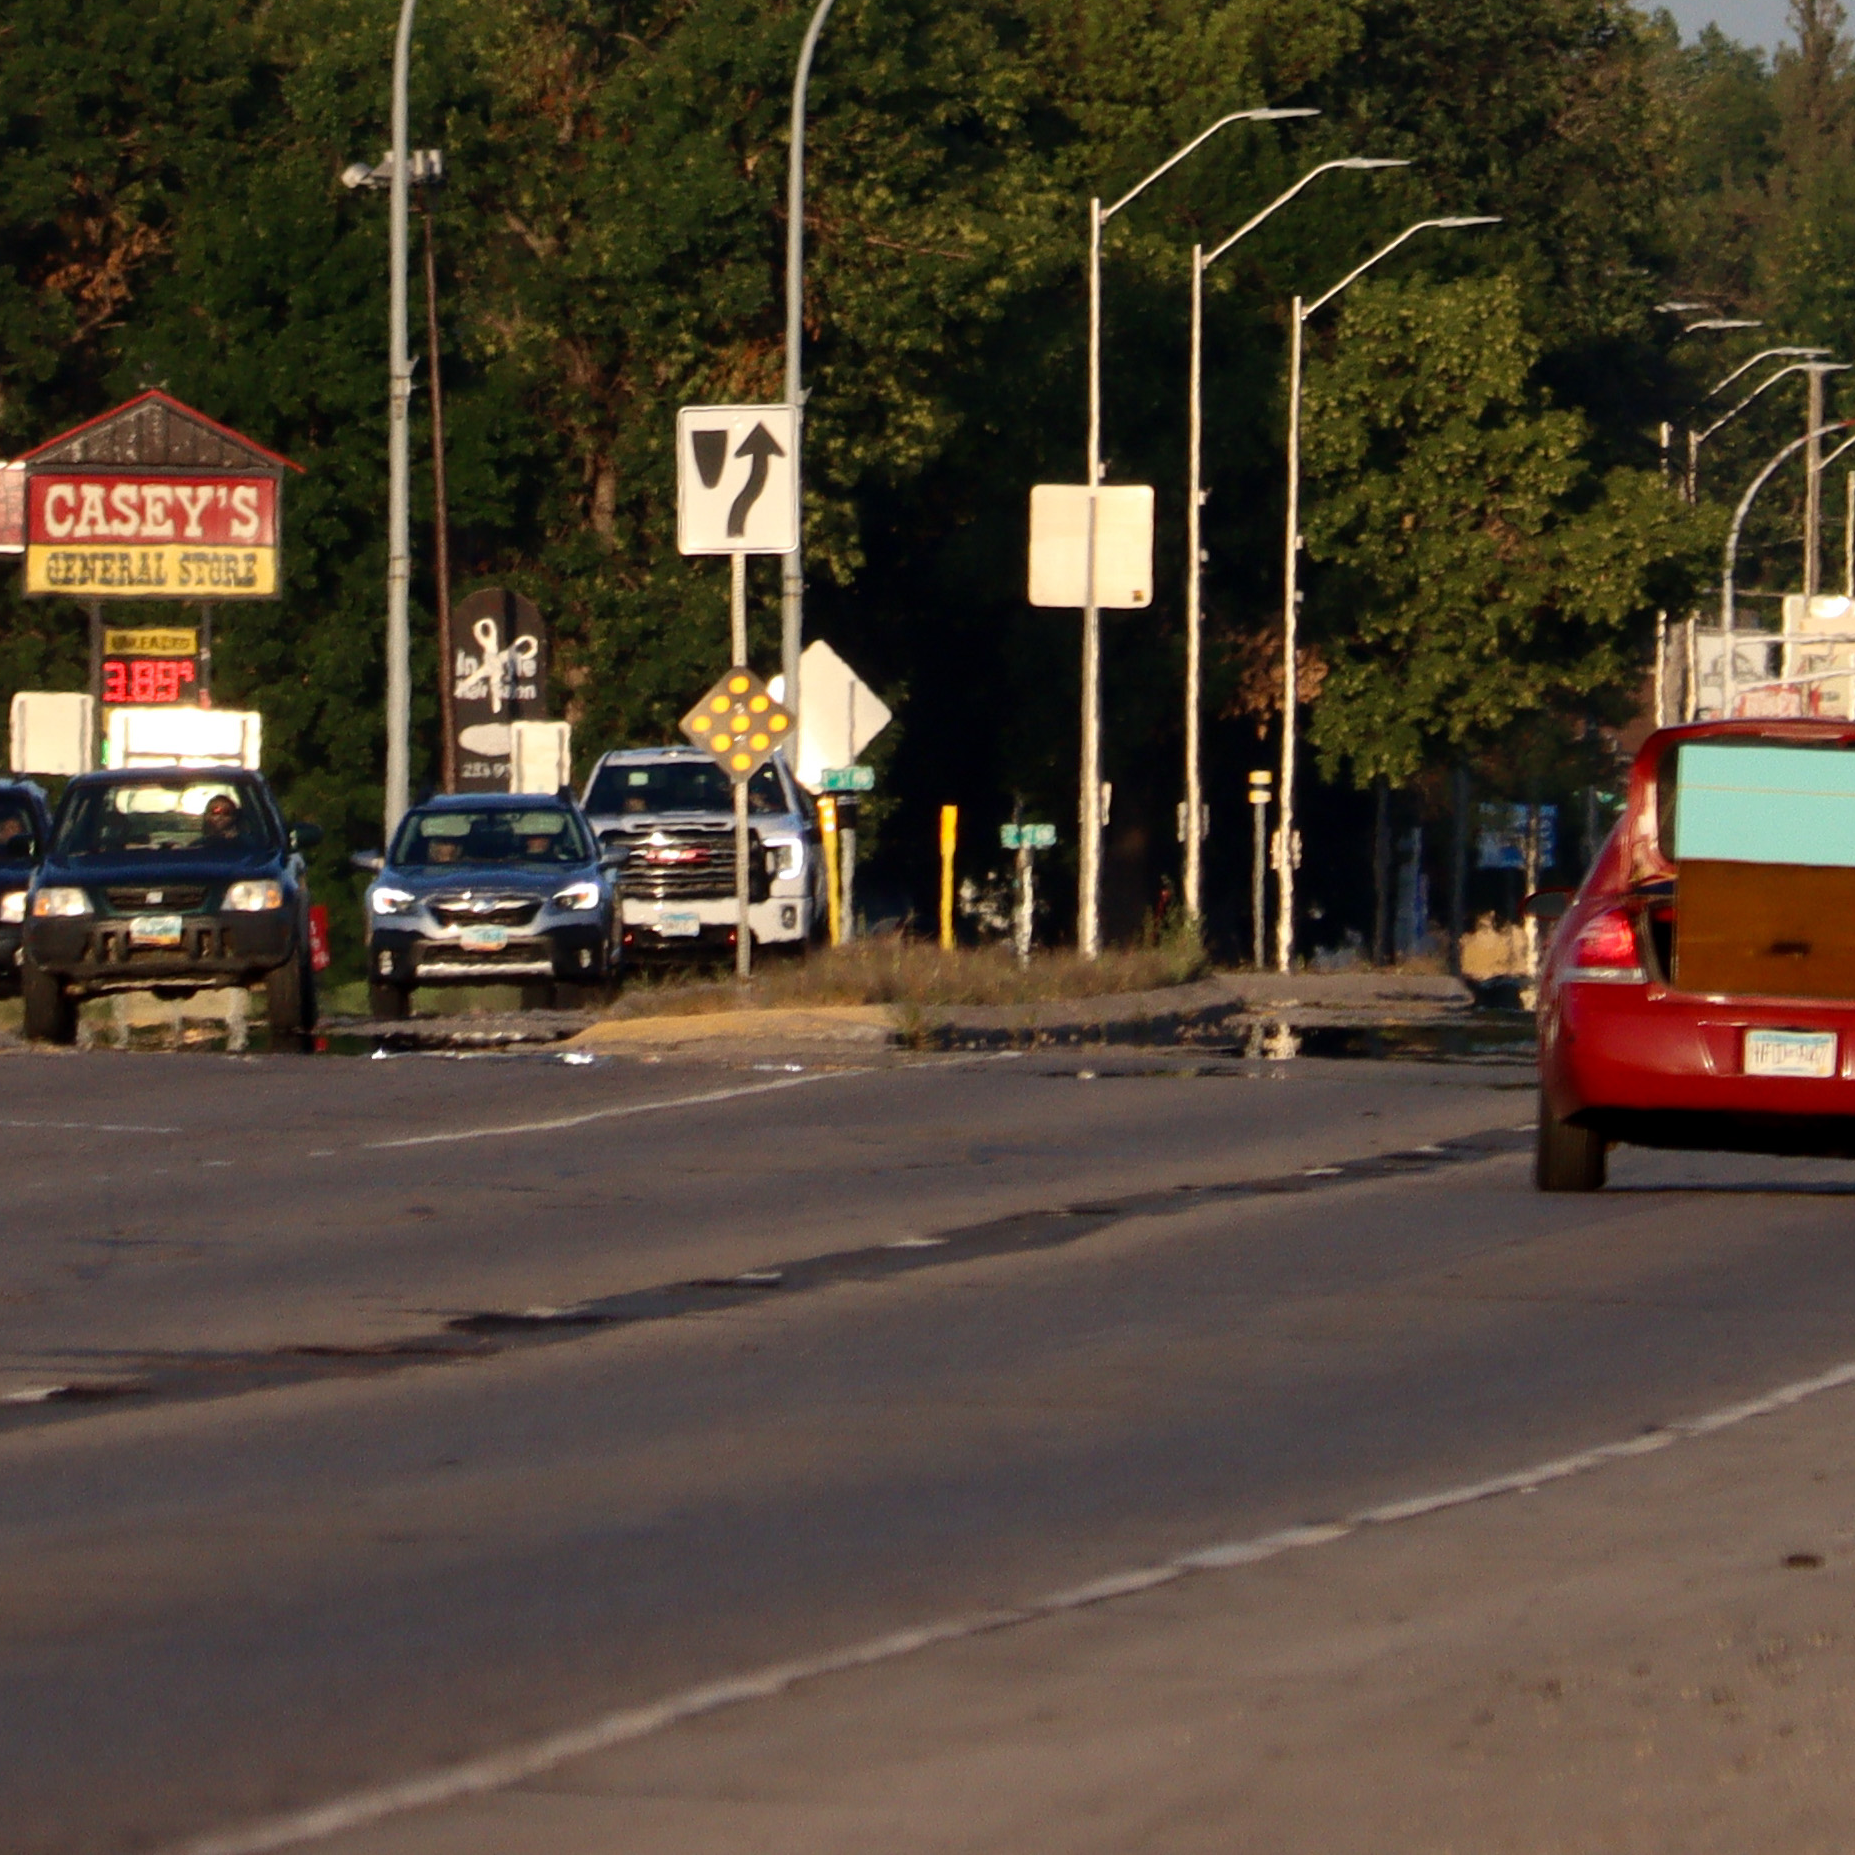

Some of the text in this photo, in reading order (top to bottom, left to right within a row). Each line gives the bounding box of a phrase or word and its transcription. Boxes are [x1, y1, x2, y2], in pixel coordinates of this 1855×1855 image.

[44, 483, 261, 539] CASEY'S
[46, 552, 258, 587] GENERAL STORE
